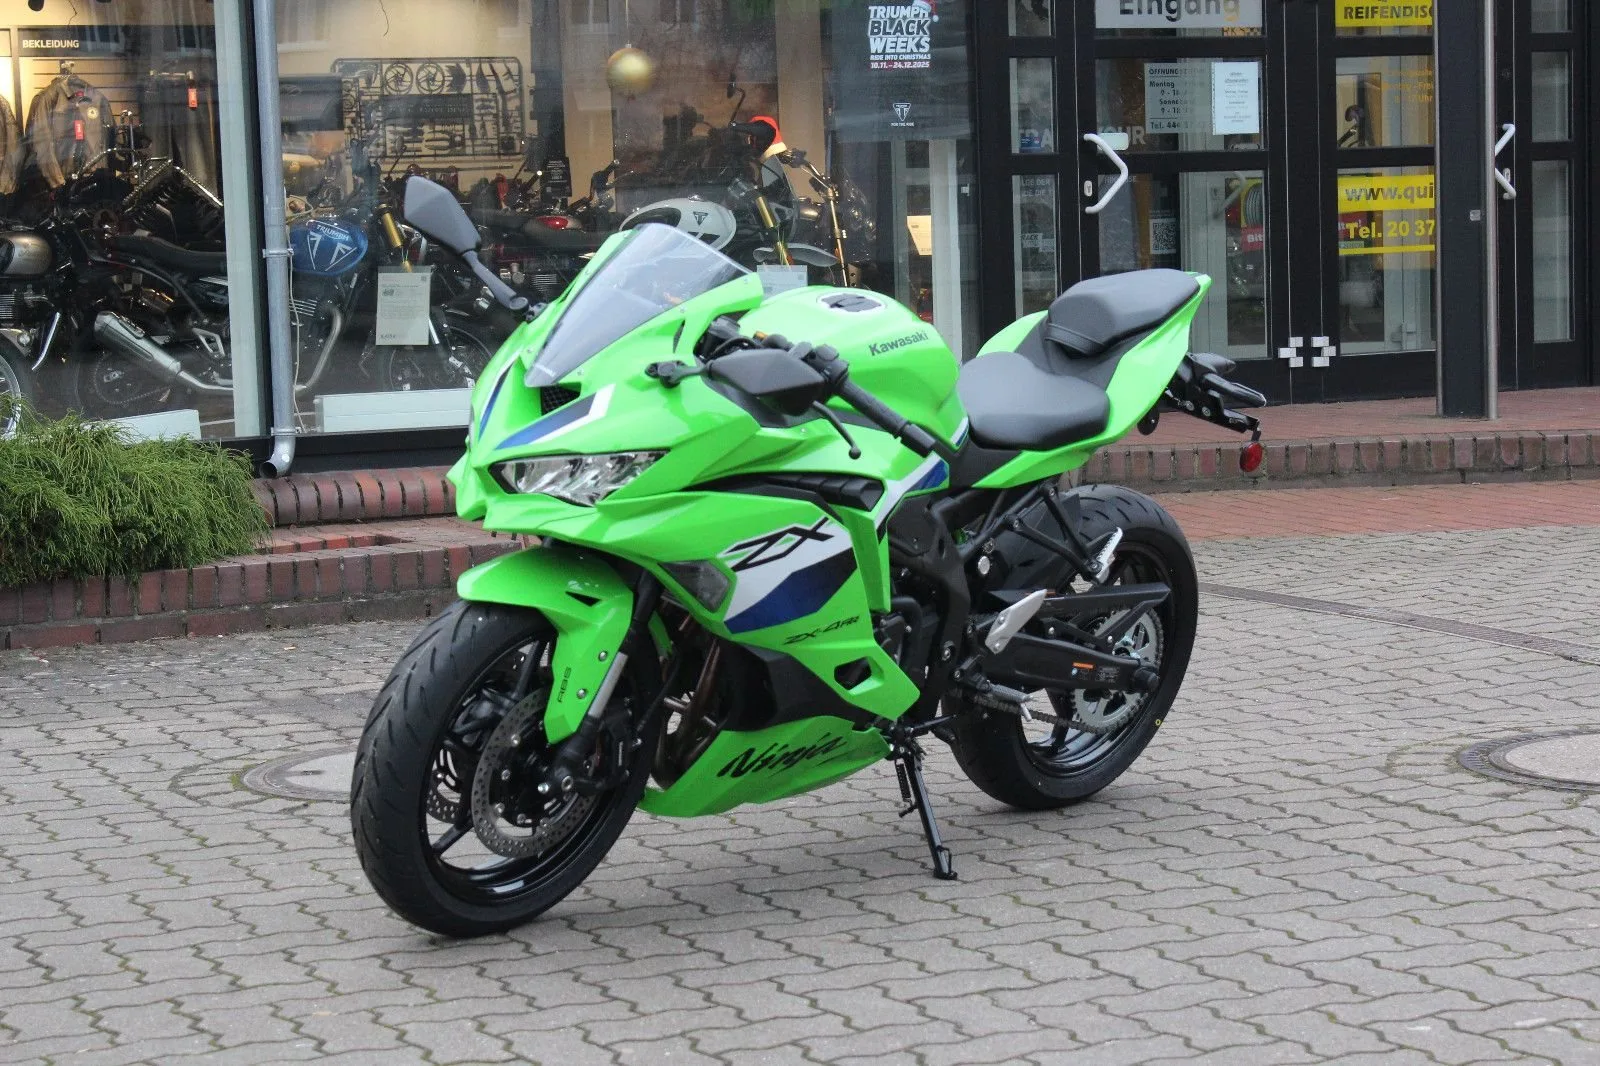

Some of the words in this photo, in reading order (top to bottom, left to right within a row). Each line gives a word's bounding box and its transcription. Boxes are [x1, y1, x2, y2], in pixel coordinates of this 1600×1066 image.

[868, 5, 929, 19] TRIUMPH
[1120, 0, 1239, 22] Eingang
[1343, 5, 1433, 19] REIFENDIS
[868, 19, 931, 36] BLACK
[22, 39, 80, 48] BEKLEIDUNG
[869, 37, 931, 53] WEEKS
[1344, 182, 1434, 204] www.qui
[316, 224, 350, 241] TRIUMPH
[1348, 221, 1382, 239] Tel.
[1387, 220, 1410, 238] 20
[1414, 219, 1435, 237] 37
[869, 330, 928, 356] Kawasaki
[723, 516, 835, 572] ZX
[557, 666, 571, 703] ABS
[716, 731, 849, 778] Ninja
